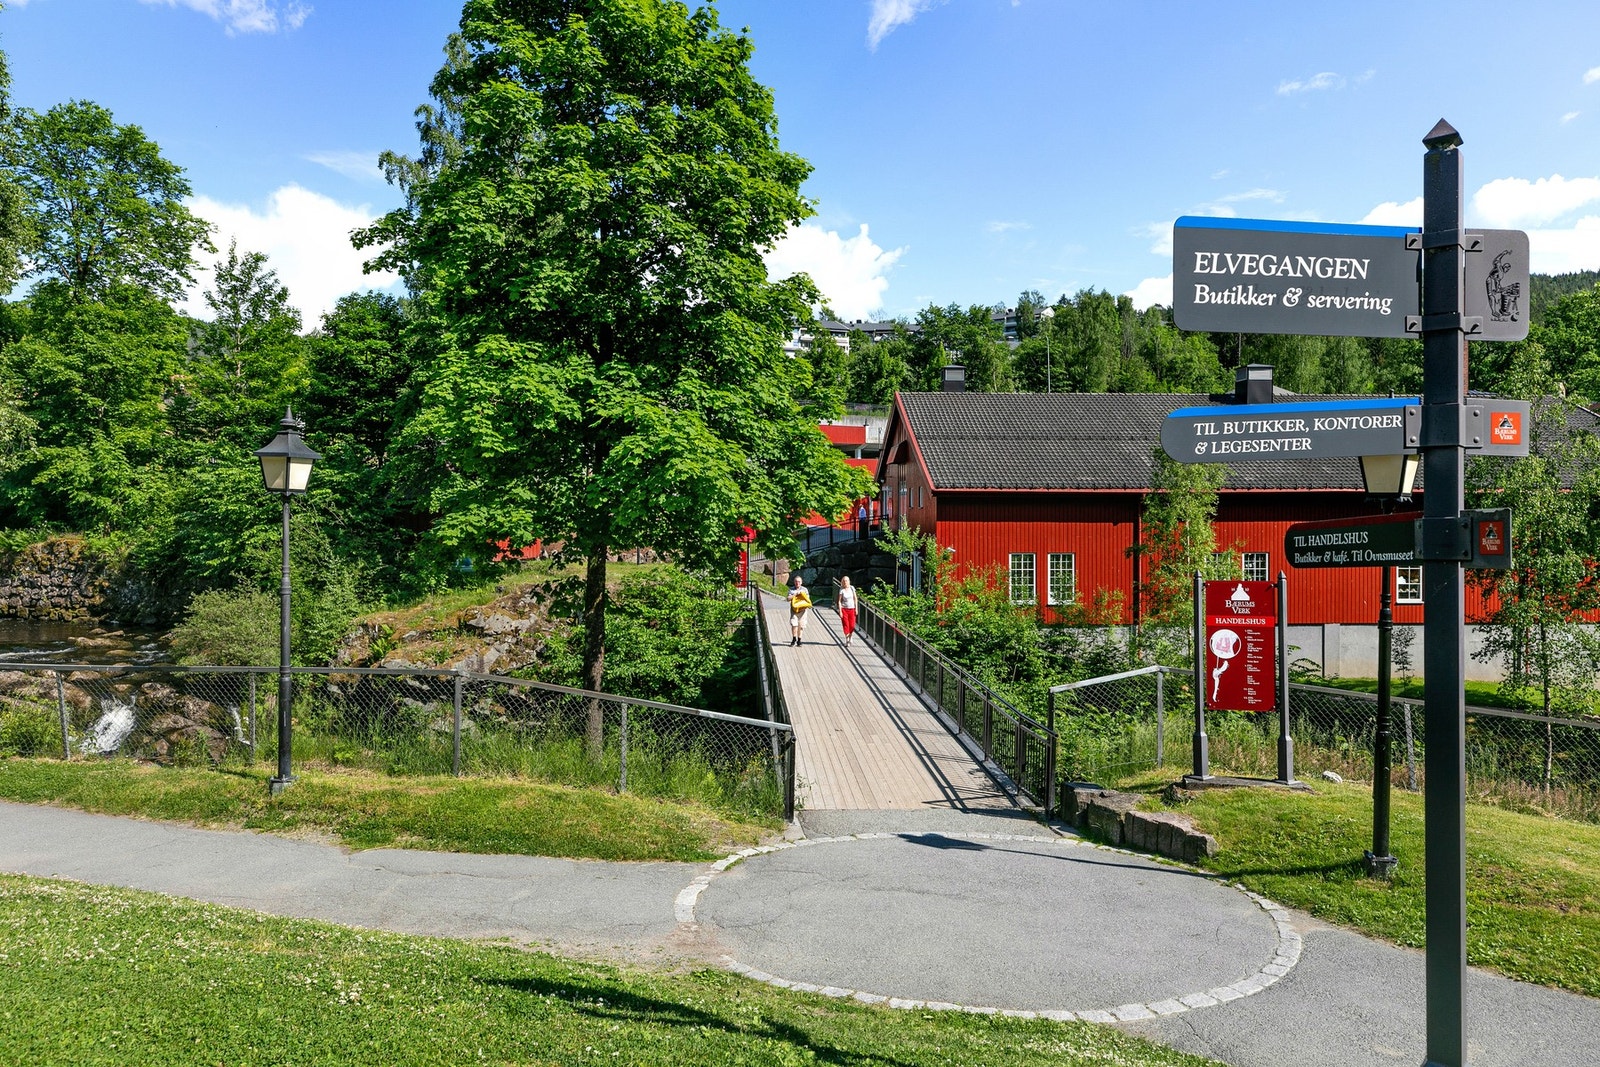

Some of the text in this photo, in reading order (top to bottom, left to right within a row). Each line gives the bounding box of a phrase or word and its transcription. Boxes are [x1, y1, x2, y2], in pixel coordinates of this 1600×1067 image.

[1193, 251, 1370, 280] ELVEGANGEN
[1193, 283, 1393, 316] Butikker & servering
[1193, 414, 1403, 436] TIL BUTIKKER, KONTORER
[1194, 437, 1313, 455] & LEGESENTER
[1293, 531, 1369, 547] TIL HANDELSHUS
[1294, 551, 1322, 564] Butikker
[1323, 551, 1332, 562] &
[1351, 549, 1363, 562] Til
[1364, 549, 1414, 562] Ovnsmuseet
[1215, 617, 1266, 625] HANDELSHUS
